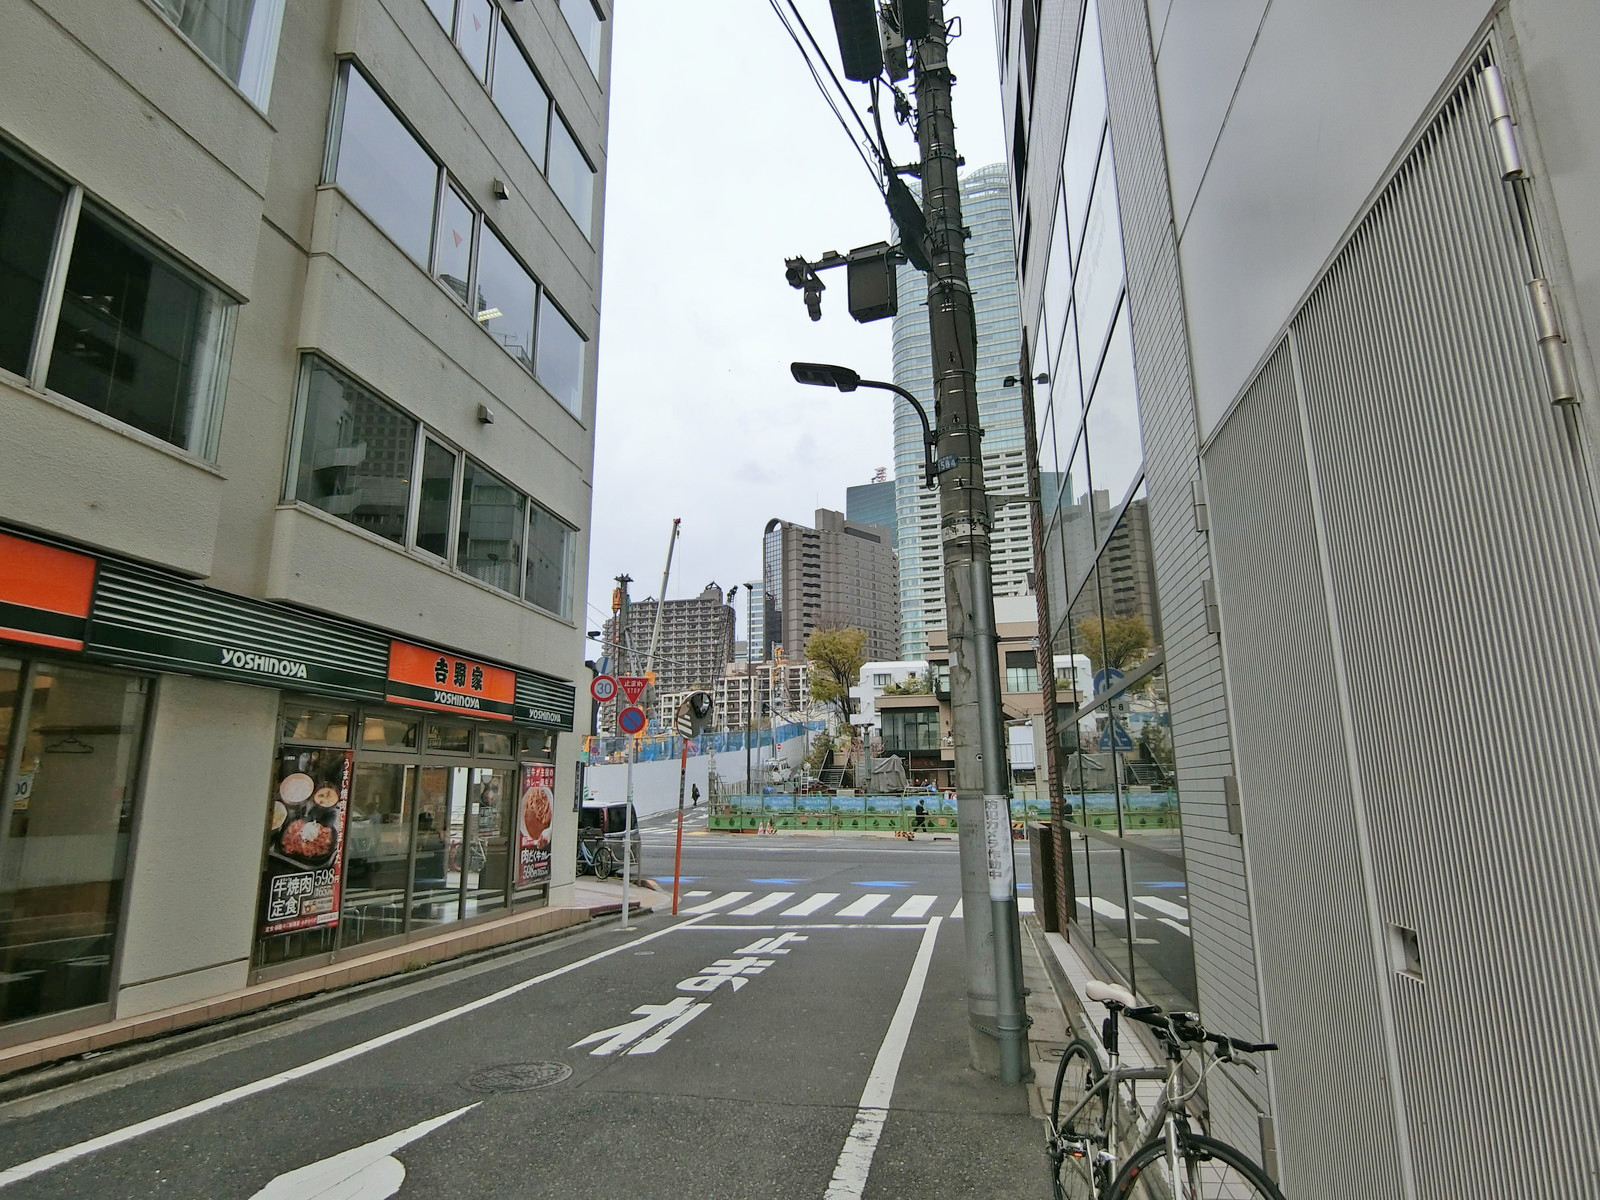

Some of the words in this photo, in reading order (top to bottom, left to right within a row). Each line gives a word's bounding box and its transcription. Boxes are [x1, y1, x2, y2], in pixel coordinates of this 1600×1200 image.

[221, 648, 307, 679] YOSHINOYA
[433, 690, 480, 709] YOSHINOYA
[597, 682, 612, 695] 30
[529, 708, 562, 723] YOSHINOYA
[273, 875, 313, 898] 牛焼肉
[271, 896, 298, 918] 定食
[568, 931, 809, 1056] 止まれ
